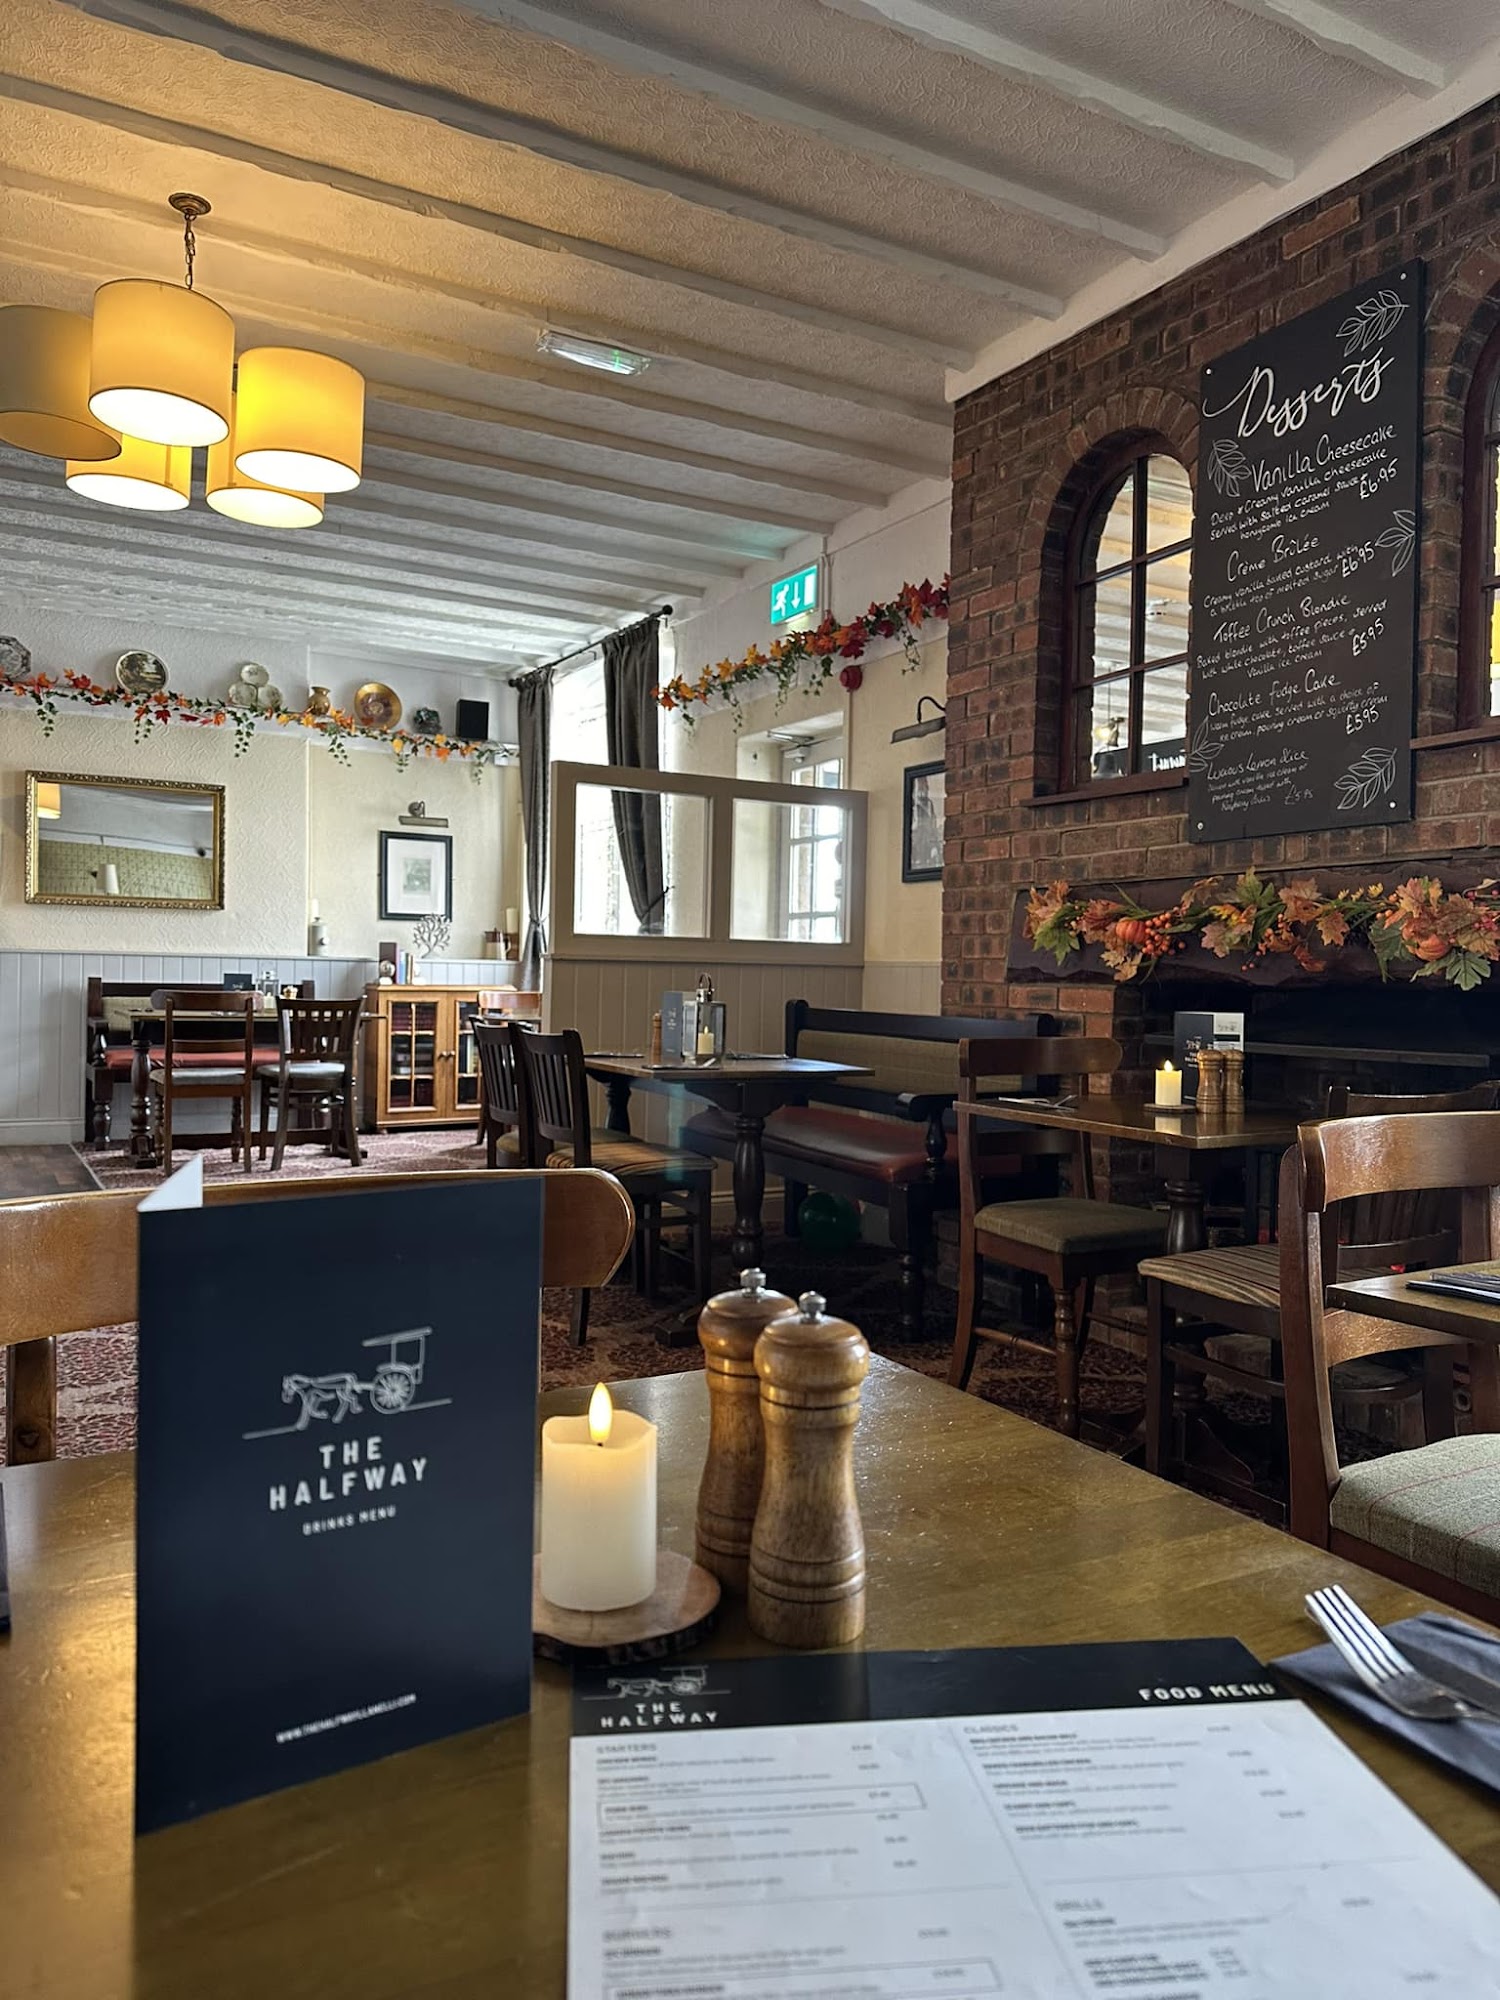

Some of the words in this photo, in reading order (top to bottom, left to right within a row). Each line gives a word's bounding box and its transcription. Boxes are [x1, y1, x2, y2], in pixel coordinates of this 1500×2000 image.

[1203, 348, 1394, 437] Desserts
[1252, 449, 1315, 492] Vanilla
[1316, 425, 1397, 465] Cheesecake
[1324, 449, 1387, 481] cheesecake
[1360, 458, 1398, 499] £6.95
[1239, 516, 1258, 529] with
[1295, 487, 1330, 508] caramel
[1241, 520, 1281, 540] honeycomb
[1300, 501, 1329, 518] cream
[1342, 541, 1375, 578] £6.95
[1213, 620, 1251, 643] Toffee
[1256, 607, 1296, 633] Crunch
[1300, 594, 1351, 618] Blondie
[1352, 617, 1384, 656] £5.95
[1209, 692, 1261, 716] Chocolate
[1305, 668, 1341, 693] Cake
[319, 1436, 382, 1469] THE
[270, 1457, 427, 1510] HALFWAY
[302, 1513, 355, 1536] DRINKS
[359, 1505, 397, 1523] MENU
[635, 1702, 682, 1714] THE
[1139, 1685, 1202, 1701] FOOD
[1208, 1683, 1276, 1698] MENU
[601, 1711, 719, 1729] HALFWAY
